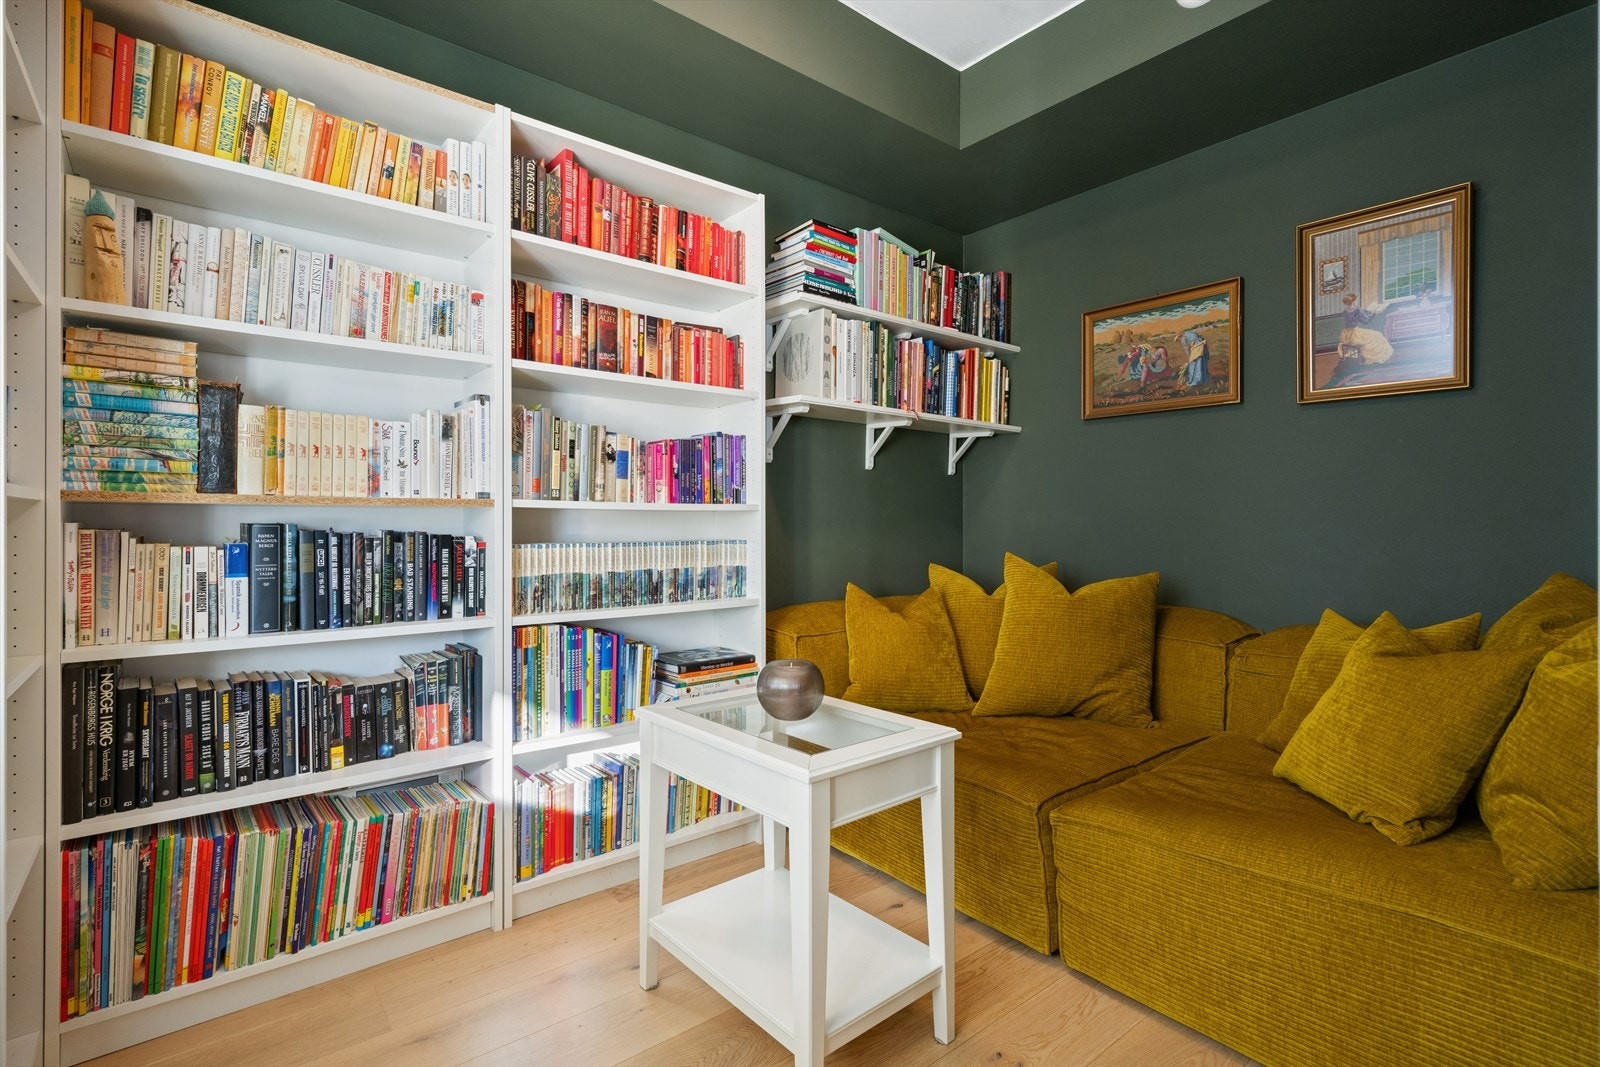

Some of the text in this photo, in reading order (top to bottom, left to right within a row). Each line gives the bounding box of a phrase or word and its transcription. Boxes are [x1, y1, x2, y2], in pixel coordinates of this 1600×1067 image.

[205, 67, 215, 97] CONROY
[257, 93, 269, 125] MANKELL
[199, 104, 213, 147] FYRSTE
[526, 162, 535, 212] CLIVE CUSSLER
[298, 264, 306, 285] SYLVIA
[311, 258, 322, 295] CUSSLER
[598, 315, 617, 324] AUEL
[80, 552, 92, 570] PLAIN
[441, 564, 449, 577] COBEN
[80, 573, 92, 595] RINGEN
[196, 571, 207, 613] DRØMMEKRIGEN
[80, 596, 91, 604] ER
[80, 604, 92, 630] SLUTTET
[100, 672, 114, 714] NORGE
[87, 691, 96, 746] ROSENBORGS HUS
[256, 701, 264, 726] GRISHAM
[99, 721, 113, 747] KRIG
[184, 733, 193, 752] SLAGET
[202, 723, 210, 741] COBEN
[235, 710, 251, 769] FIRMAETS MANN
[271, 728, 280, 764] BARE DEG
